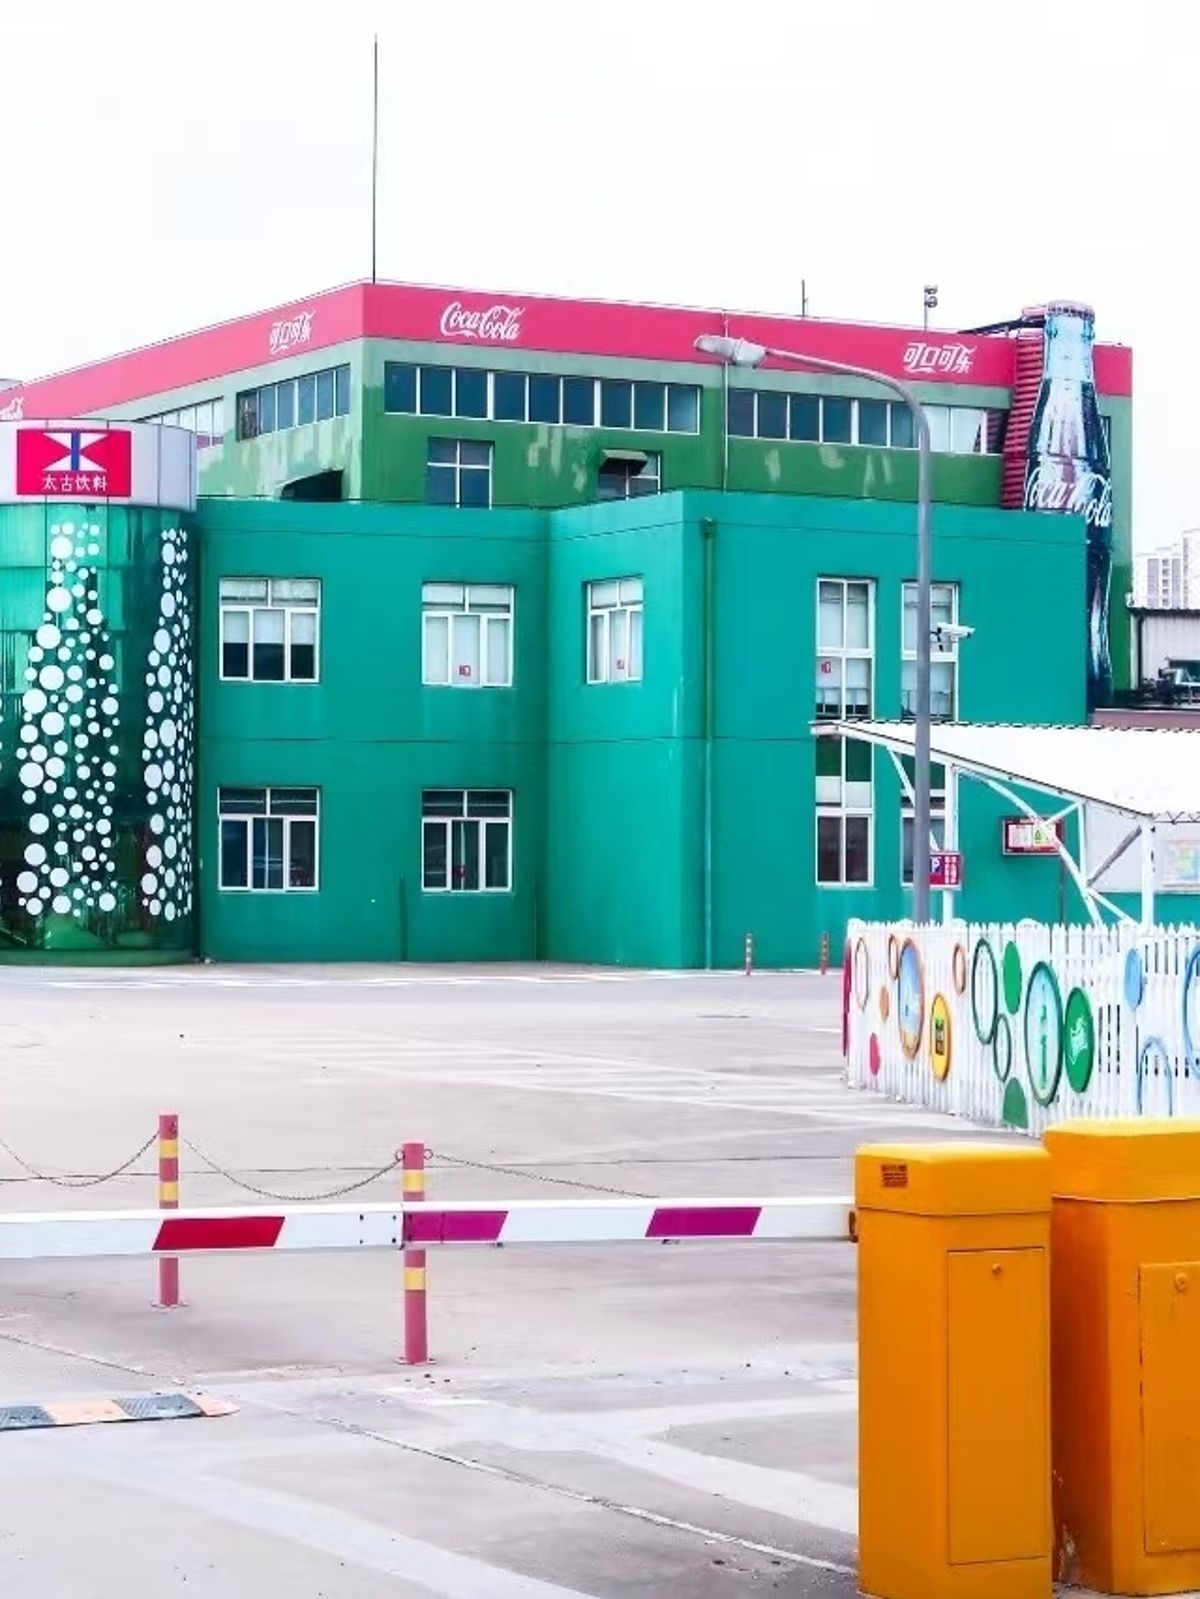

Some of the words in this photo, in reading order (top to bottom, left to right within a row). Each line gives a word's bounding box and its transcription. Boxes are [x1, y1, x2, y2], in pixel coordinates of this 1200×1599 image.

[904, 343, 977, 374] 可口可乐
[41, 474, 108, 492] 太古饮料
